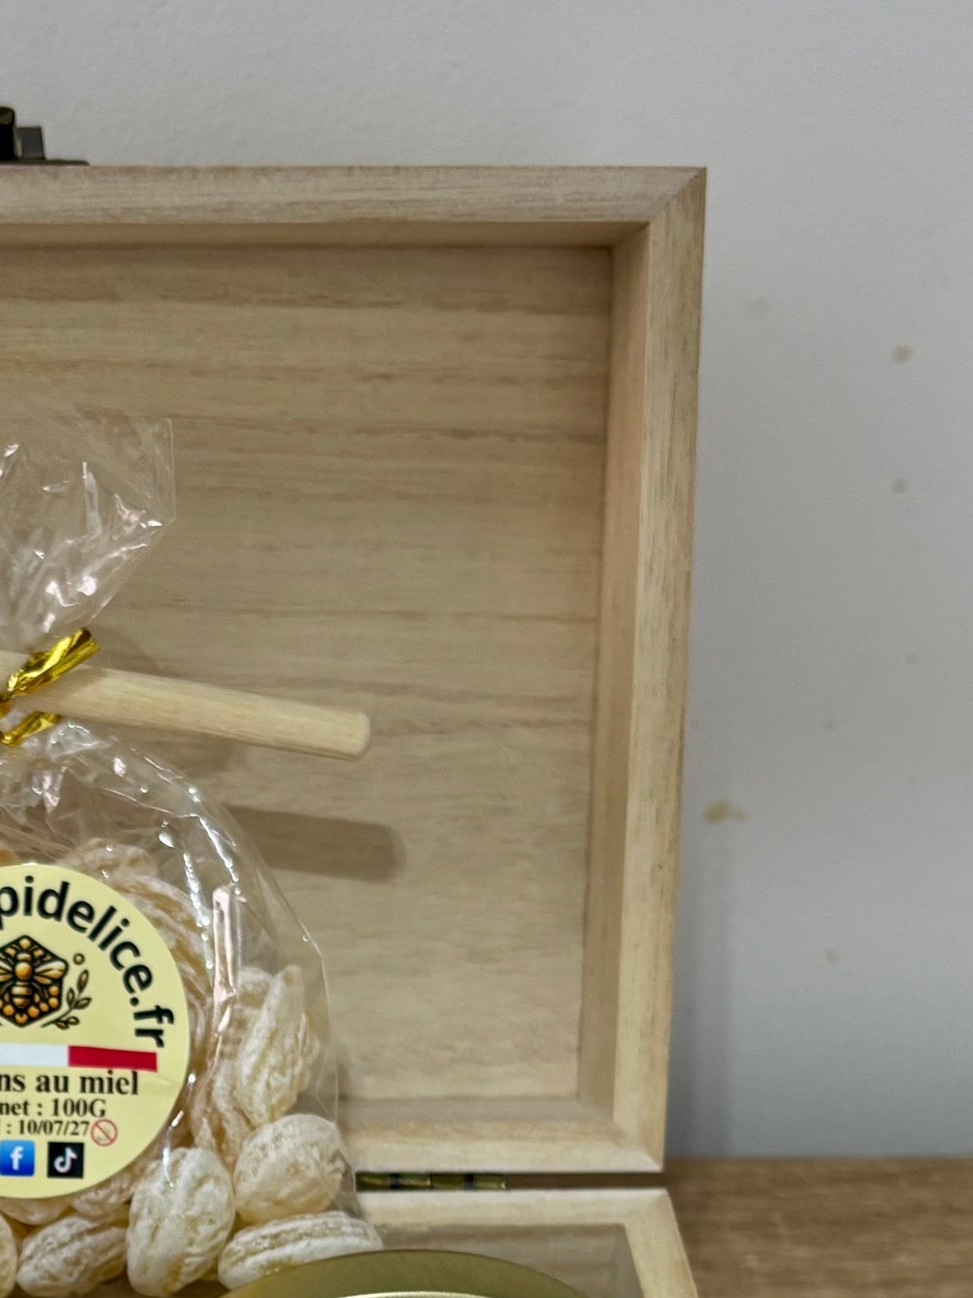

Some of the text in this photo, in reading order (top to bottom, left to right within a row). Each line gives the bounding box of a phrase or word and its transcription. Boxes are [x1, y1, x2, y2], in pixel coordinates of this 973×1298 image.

[35, 1074, 70, 1094] au
[79, 1071, 139, 1096] miel
[51, 1098, 106, 1119] 100G
[18, 1119, 90, 1137] 10/07/27
